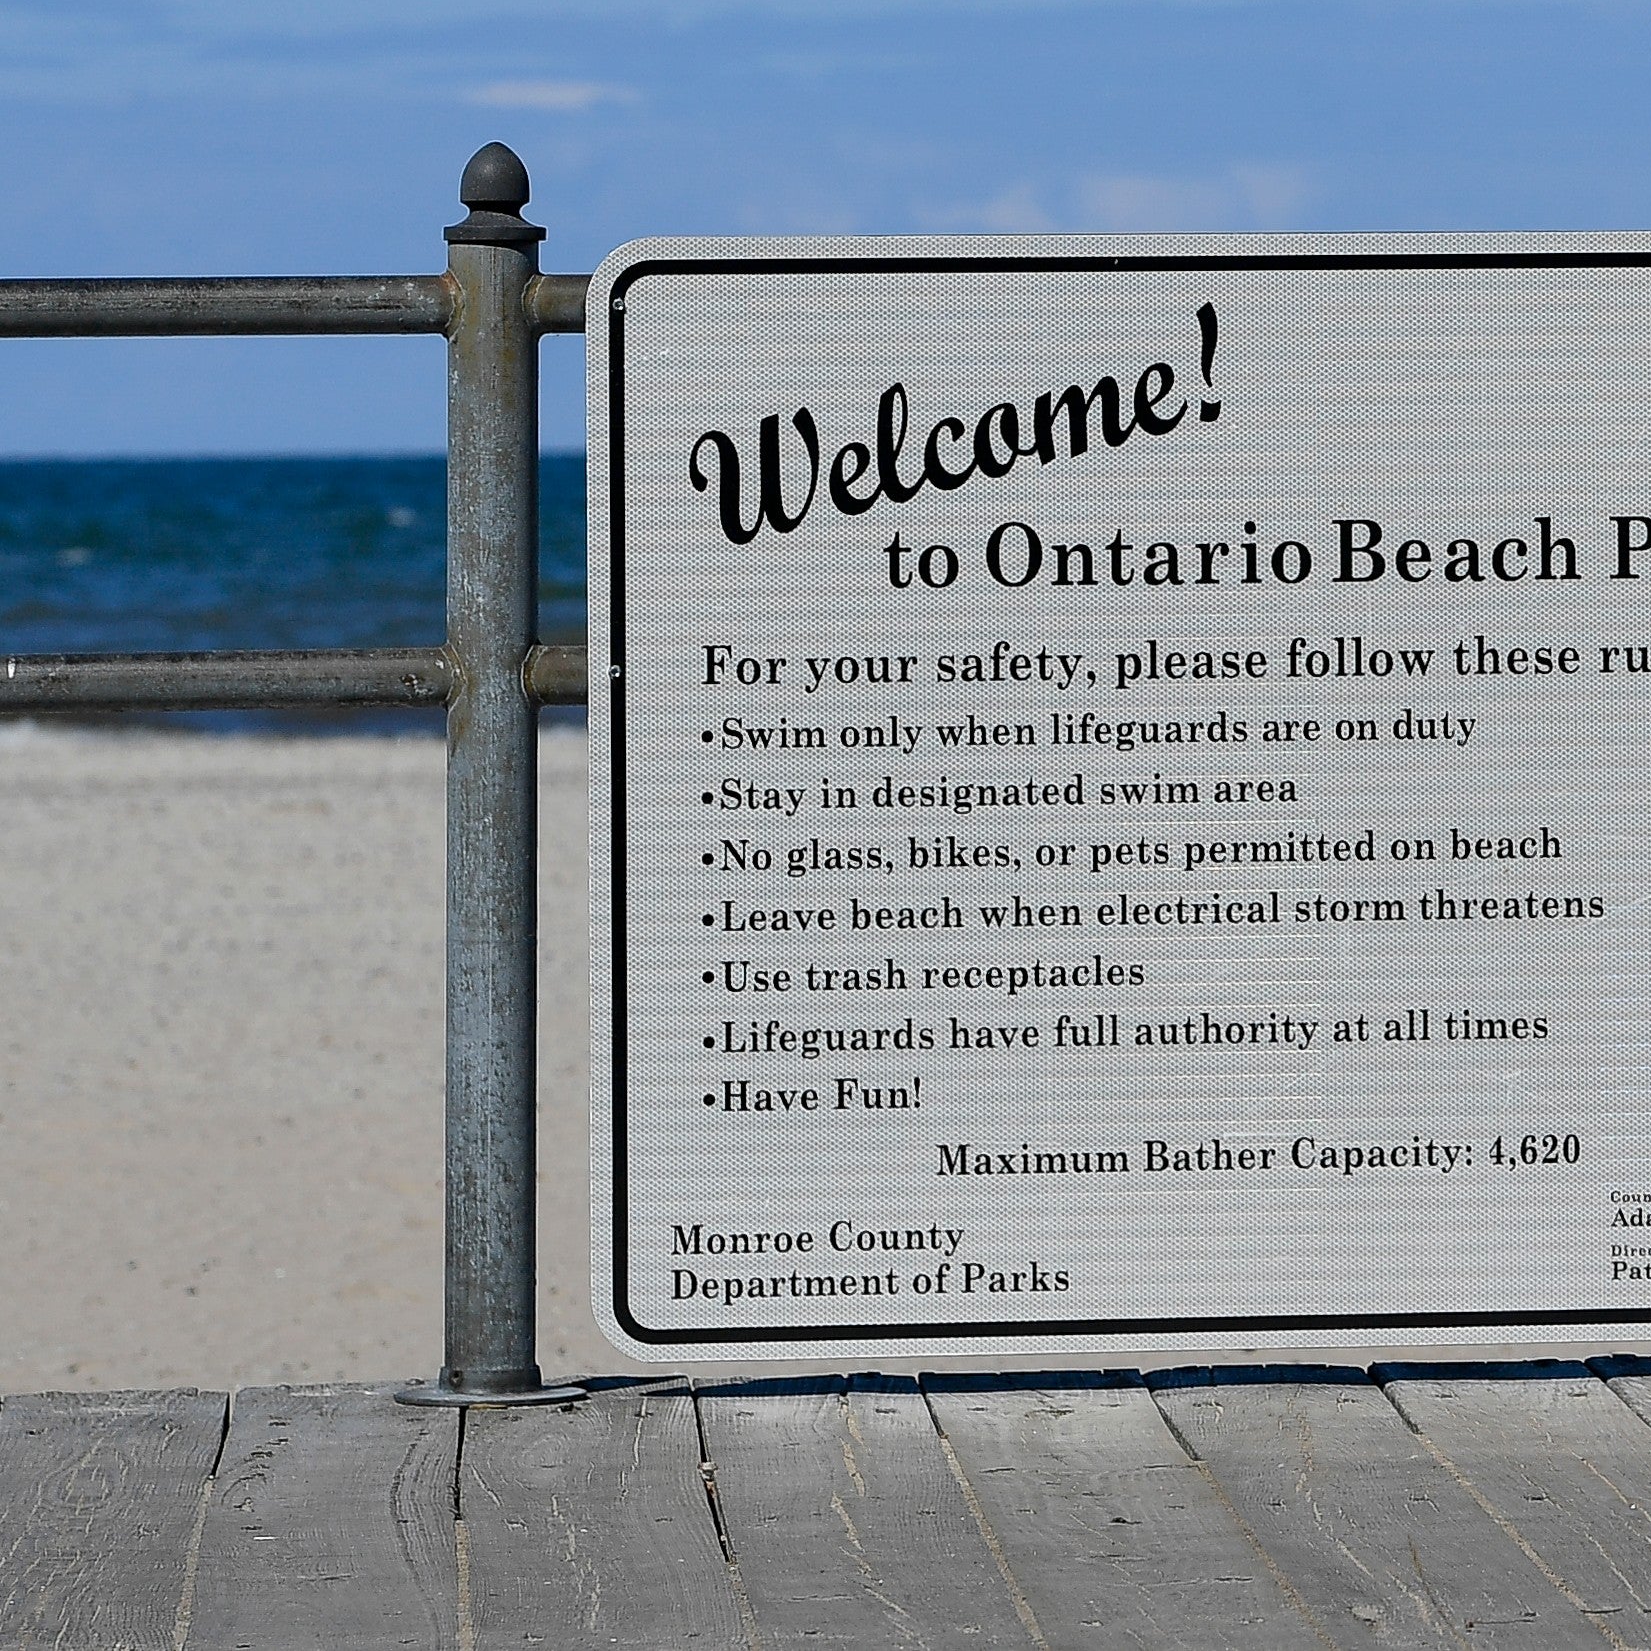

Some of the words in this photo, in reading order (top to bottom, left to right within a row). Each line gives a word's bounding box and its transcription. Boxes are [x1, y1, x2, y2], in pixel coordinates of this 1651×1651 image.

[688, 301, 1222, 546] Welcome!
[883, 531, 960, 589] to
[985, 520, 1312, 588] Ontario
[1332, 516, 1582, 583] Beach
[703, 644, 787, 686] For
[805, 656, 918, 694] your
[937, 640, 1097, 690] safety,
[1116, 639, 1267, 690] please
[1287, 636, 1435, 678] follow
[1453, 635, 1580, 676] these
[722, 717, 826, 749] Swim
[839, 715, 922, 755] only
[936, 714, 1036, 746] when
[1051, 711, 1248, 752] lifeguards
[1262, 720, 1321, 742] are
[1335, 719, 1378, 741] on
[1392, 708, 1476, 747] duty
[720, 778, 804, 817] Stay
[822, 778, 857, 809] in
[872, 773, 1084, 814] designated
[1100, 773, 1199, 804] swim
[1214, 780, 1297, 803] area
[721, 839, 772, 872] No
[787, 838, 894, 877] glass,
[908, 835, 1021, 869] bikes,
[1035, 844, 1076, 866] or
[1091, 839, 1169, 873] pets
[1185, 829, 1375, 872] permitted
[1390, 839, 1436, 861] on
[1450, 826, 1562, 860] beach
[723, 900, 835, 932] Leave
[851, 896, 963, 930] beach
[979, 895, 1082, 927] when
[1097, 891, 1280, 926] electrical
[1295, 896, 1405, 922] storm
[1419, 888, 1604, 921] threatens
[722, 960, 791, 993] Use
[805, 958, 907, 991] trash
[923, 954, 1144, 996] receptacles
[723, 1018, 935, 1059] Lifeguards
[950, 1017, 1039, 1049] have
[1055, 1014, 1119, 1047] full
[1134, 1012, 1318, 1049] authority
[1333, 1015, 1368, 1042] at
[1383, 1009, 1430, 1041] all
[1444, 1009, 1548, 1040] times
[722, 1080, 818, 1112] Have
[835, 1076, 921, 1110] Fun!
[937, 1144, 1129, 1176] Maximum
[1144, 1138, 1275, 1172] Bather
[1291, 1137, 1474, 1176] Capacity:
[1488, 1134, 1580, 1167] 4,620
[673, 1224, 813, 1255] Monroe
[829, 1221, 964, 1256] County
[672, 1269, 898, 1306] Department
[912, 1263, 951, 1294] of
[963, 1261, 1069, 1293] Parks
